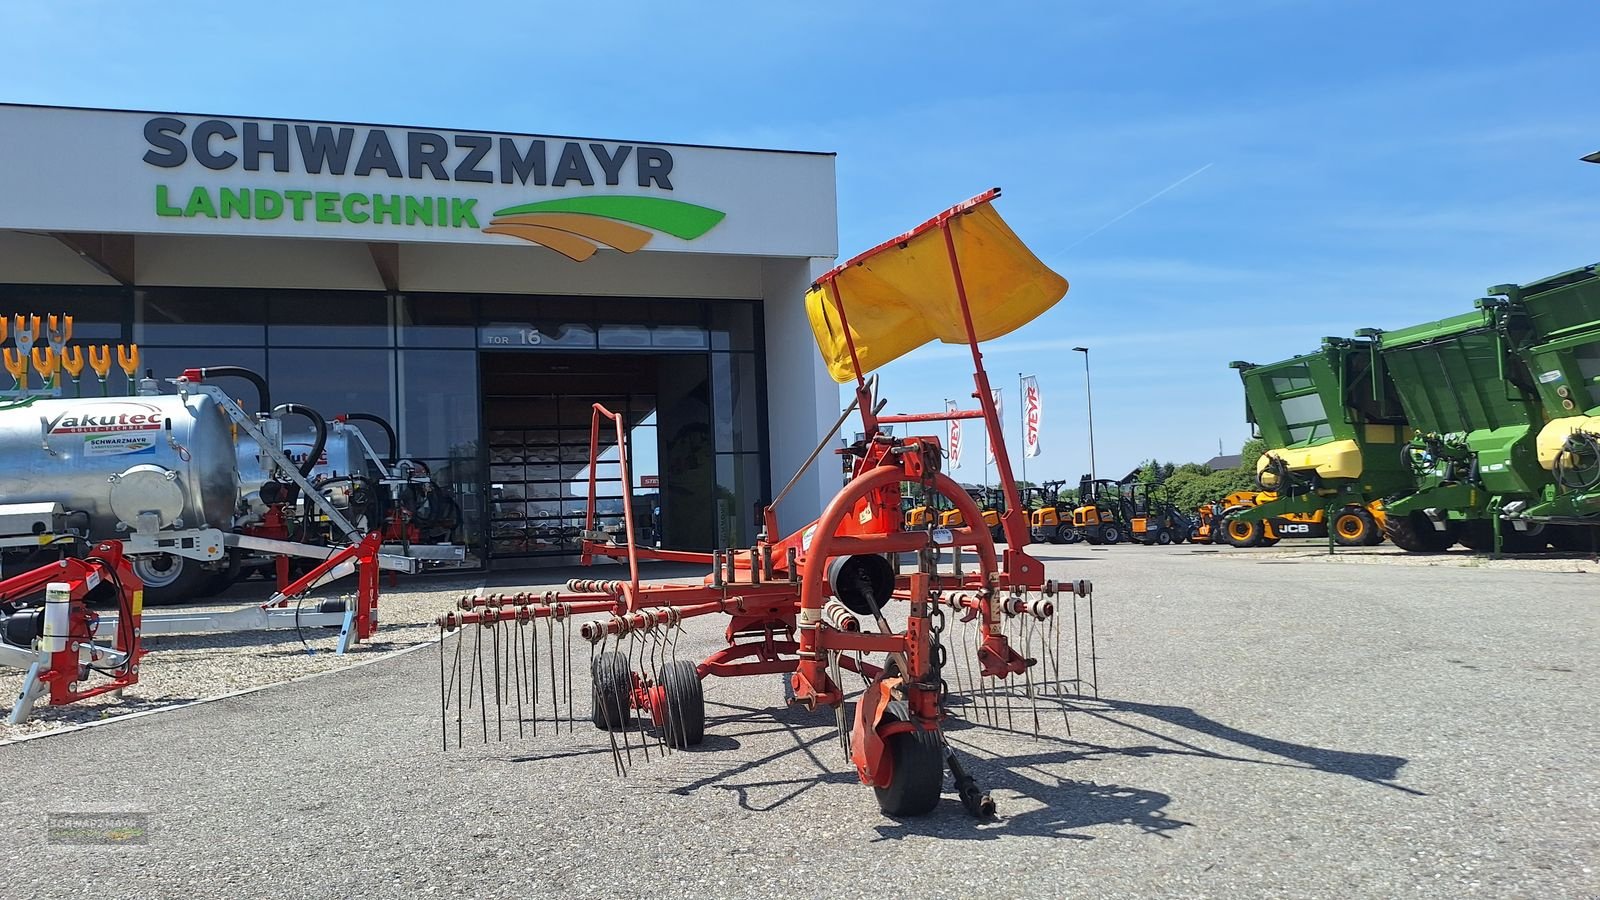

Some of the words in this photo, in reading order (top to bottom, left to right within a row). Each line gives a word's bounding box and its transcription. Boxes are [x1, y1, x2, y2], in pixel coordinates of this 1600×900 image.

[142, 117, 674, 190] SCHWARZMAYR
[155, 184, 481, 228] LANDTECHNIK
[487, 336, 509, 344] TOR
[520, 329, 541, 345] 16
[40, 411, 162, 434] Vakutec
[1027, 386, 1038, 446] STEYR
[91, 437, 147, 445] SCHWARZMAYR
[951, 408, 959, 462] STEY
[1279, 524, 1309, 533] JCB
